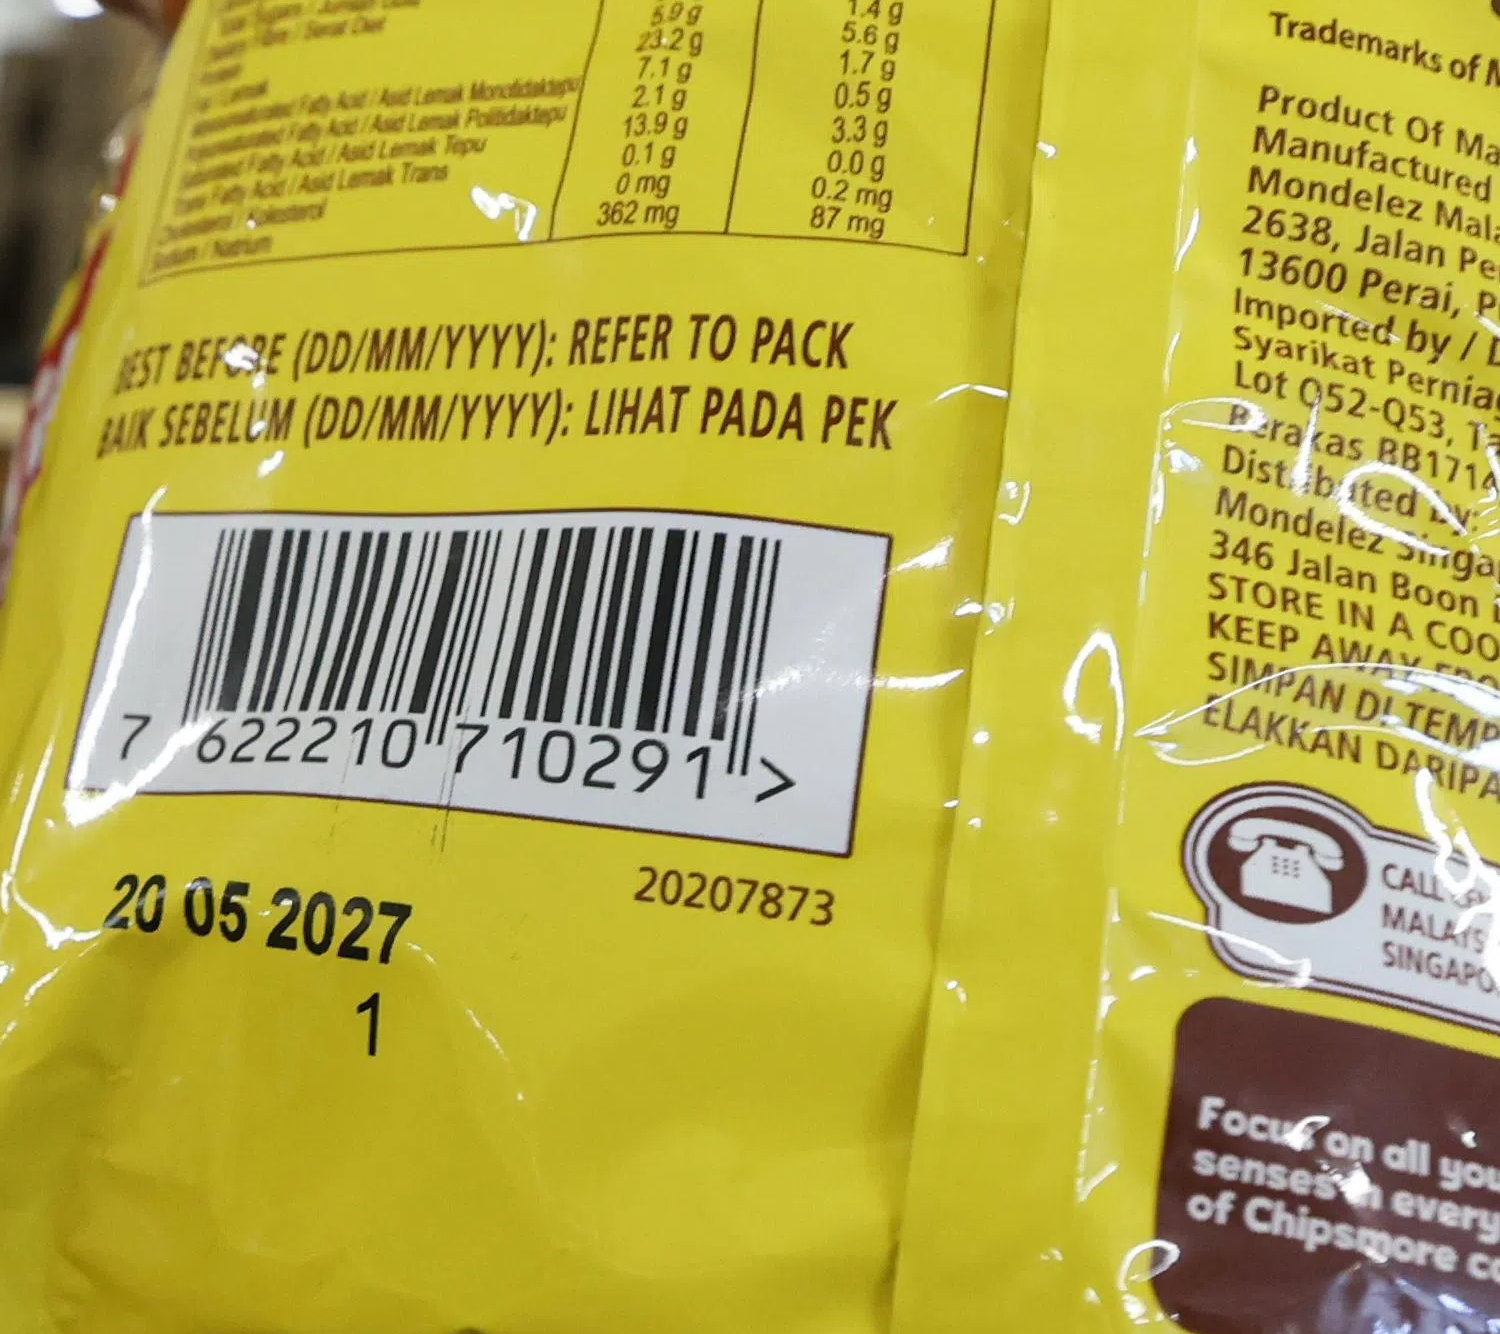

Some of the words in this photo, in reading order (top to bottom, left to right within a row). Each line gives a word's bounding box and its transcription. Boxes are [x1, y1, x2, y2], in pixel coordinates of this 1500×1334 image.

[841, 22, 878, 46] 5.6
[1269, 11, 1442, 73] Trademarks
[1450, 54, 1481, 81] of
[623, 111, 668, 137] 13.9
[834, 82, 871, 109] 0.5
[1258, 84, 1394, 135] Product
[1406, 116, 1444, 147] Of
[831, 117, 868, 143] 3.3
[811, 176, 849, 203] 0.2
[1247, 165, 1423, 221] Mondelez
[1252, 125, 1491, 203] Manufactured
[596, 201, 636, 227] 362
[810, 205, 841, 231] 87
[1242, 205, 1339, 253] 2638,
[1354, 225, 1446, 267] Jalan
[1240, 247, 1348, 293] 13600
[1358, 268, 1460, 319] Perai,
[293, 319, 558, 382] (DD/MM/YYYY):
[568, 314, 673, 366] REFER
[688, 313, 738, 362] TO
[750, 317, 854, 369] PACK
[1233, 288, 1396, 345] Imported
[1406, 319, 1451, 364] by
[1233, 325, 1376, 379] Syarikat
[159, 398, 297, 448] SEBELUM
[303, 388, 574, 449] (DD/MM/YYYY):
[584, 385, 691, 436] LIHAT
[699, 386, 804, 442] PADA
[820, 394, 898, 450] PEK
[1235, 361, 1288, 399] Lot
[1300, 376, 1453, 447] Q52-Q53,
[1209, 529, 1274, 570] 346
[1287, 549, 1377, 594] Jalan
[1391, 572, 1479, 618] Boon
[1207, 572, 1323, 620] STORE
[1338, 599, 1374, 631] IN
[1388, 612, 1414, 641] A
[1207, 611, 1300, 652] KEEP
[1311, 633, 1422, 682] AWAY
[1207, 651, 1346, 713] SIMPAN
[120, 714, 152, 760] 7
[196, 718, 419, 769] 622210
[454, 723, 712, 799] 710291
[1202, 694, 1362, 764] ELAKKAN
[103, 874, 167, 933] 20
[184, 876, 250, 942] 05
[267, 887, 413, 965] 2027
[634, 865, 835, 927] 20207873
[356, 992, 380, 1057] 1
[1191, 1147, 1337, 1202] senses
[1323, 1129, 1374, 1162] on
[1382, 1140, 1432, 1178] all
[1186, 1189, 1236, 1225] of
[1243, 1196, 1459, 1273] Chipsmore
